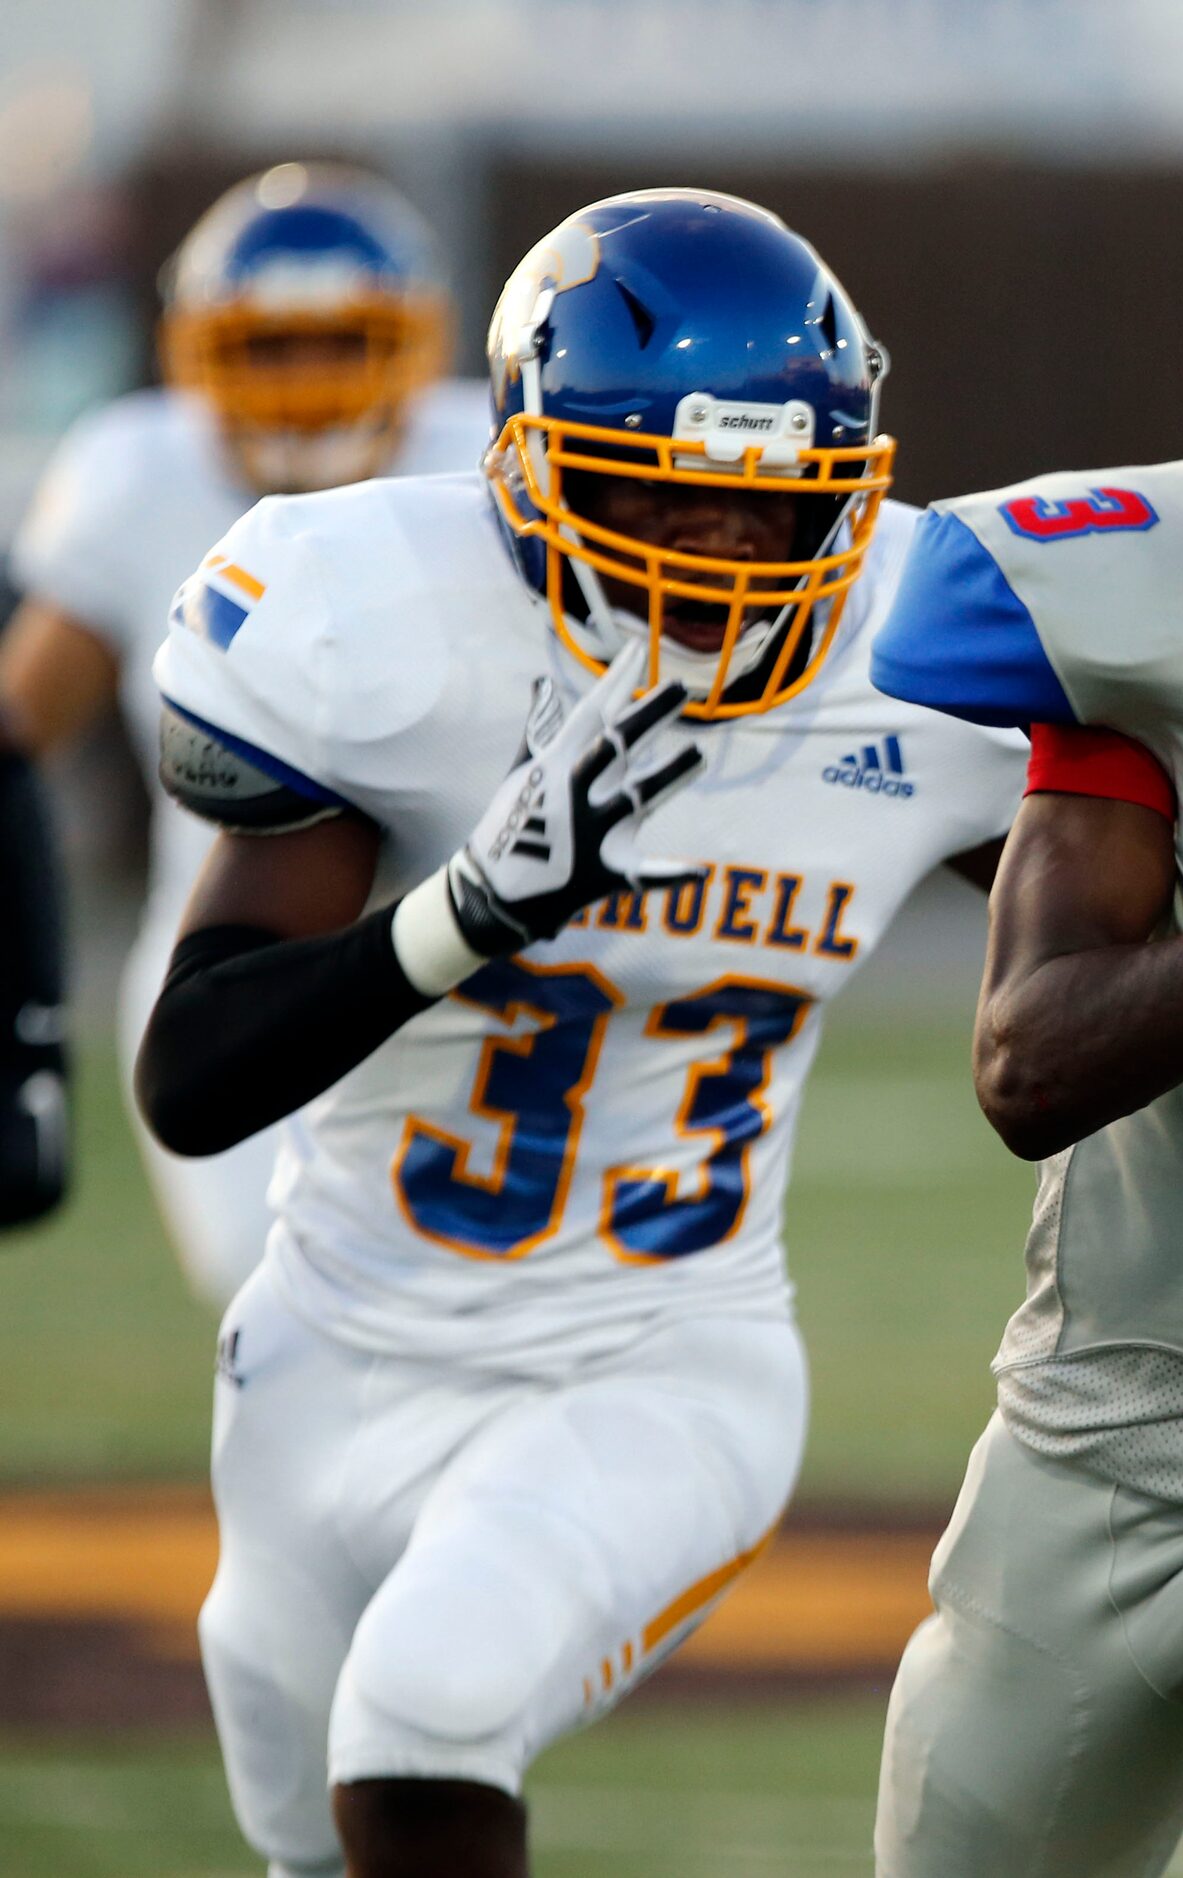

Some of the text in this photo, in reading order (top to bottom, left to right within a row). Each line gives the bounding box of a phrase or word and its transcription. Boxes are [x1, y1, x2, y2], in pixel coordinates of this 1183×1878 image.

[719, 414, 774, 430] schutt
[997, 487, 1160, 544] 3
[821, 766, 914, 797] adidas
[391, 953, 820, 1266] 33
